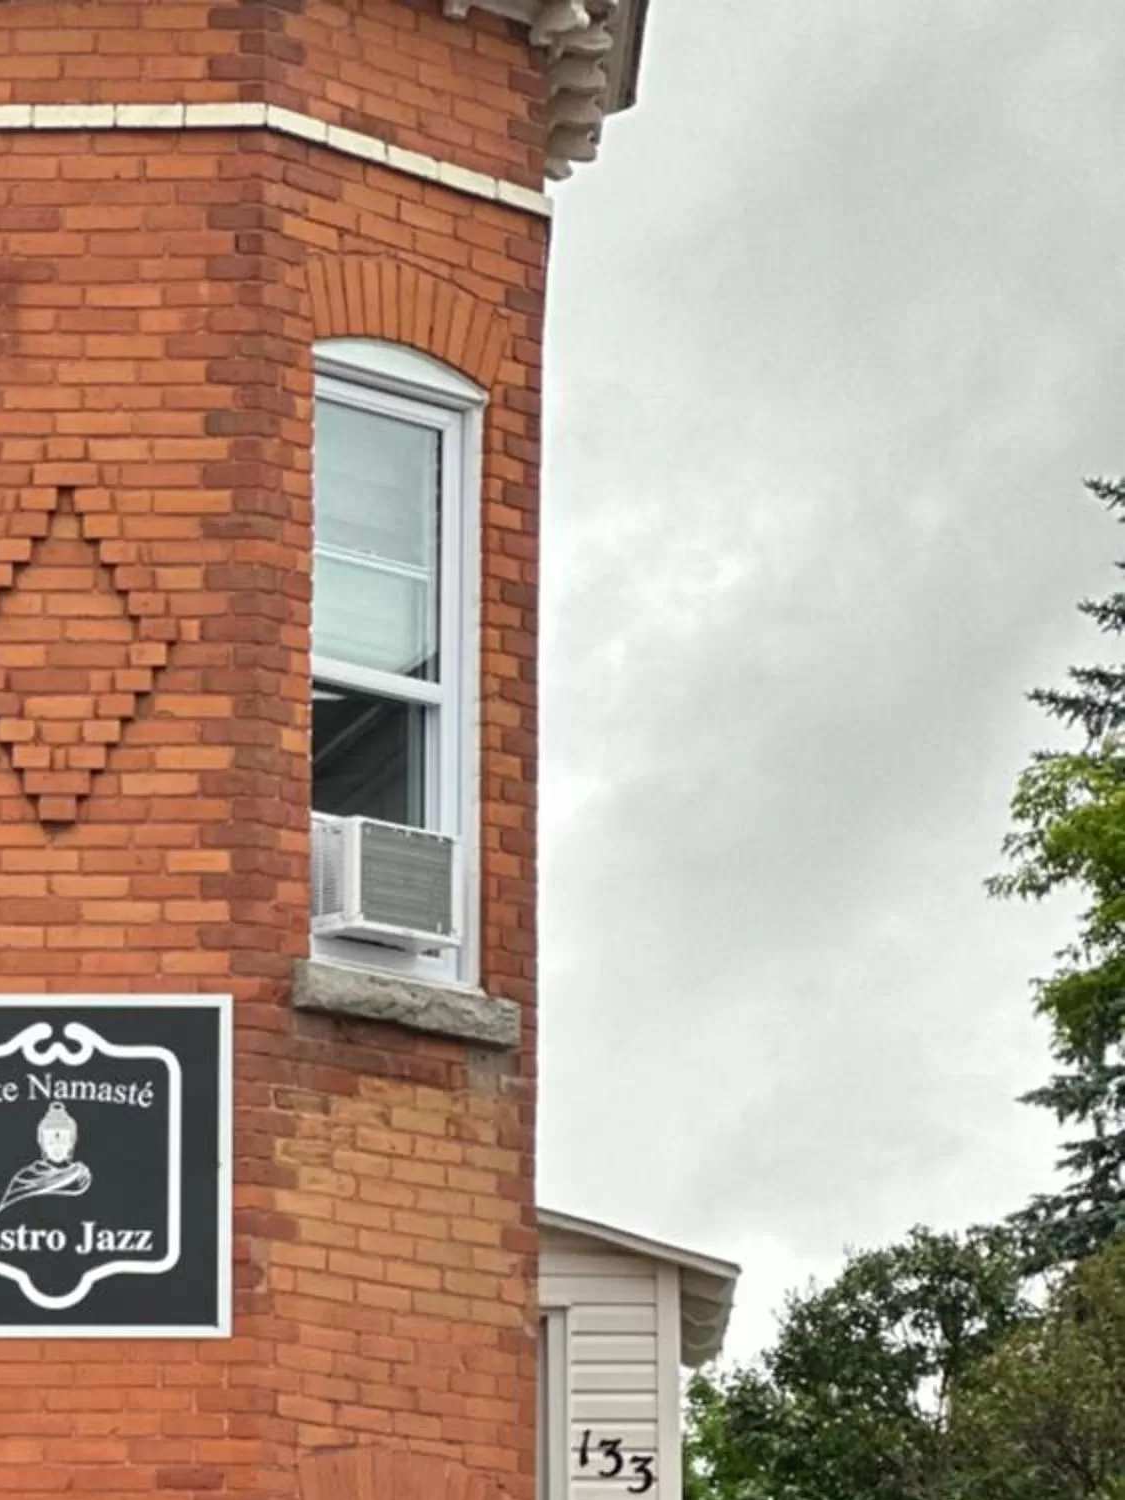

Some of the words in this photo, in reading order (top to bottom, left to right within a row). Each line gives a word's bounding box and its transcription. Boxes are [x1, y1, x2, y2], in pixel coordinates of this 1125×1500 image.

[26, 1073, 155, 1108] Namasté
[75, 1220, 154, 1255] Jazz
[578, 1428, 655, 1495] 133
